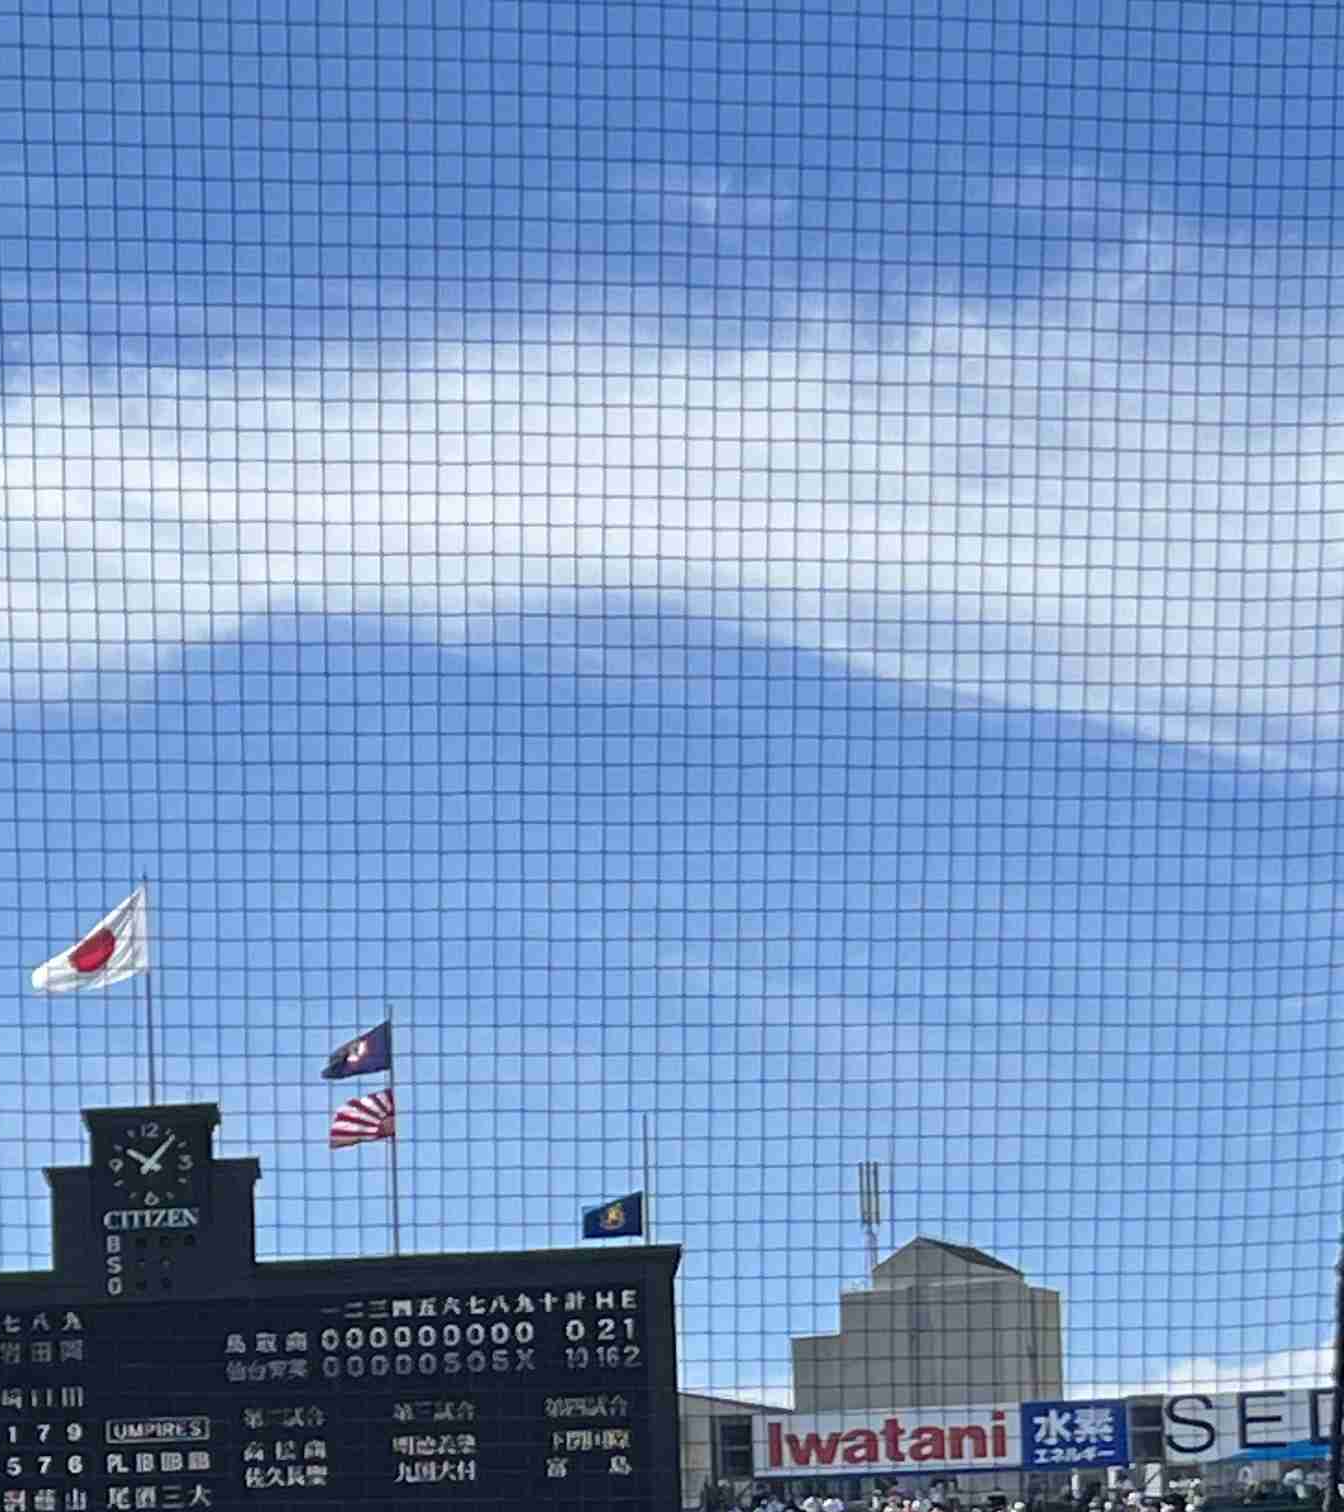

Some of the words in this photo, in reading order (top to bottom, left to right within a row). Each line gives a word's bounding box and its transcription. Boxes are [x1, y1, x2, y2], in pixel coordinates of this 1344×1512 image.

[141, 1122, 159, 1138] 12
[178, 1154, 193, 1170] 3
[144, 1191, 159, 1206] 6
[103, 1207, 199, 1230] CITIZEN
[107, 1235, 120, 1253] B
[106, 1256, 122, 1274] S
[596, 1291, 614, 1310] H
[622, 1289, 638, 1309] E
[598, 1319, 616, 1340] 2
[8, 1426, 17, 1443] 1
[37, 1424, 50, 1442] 7
[67, 1424, 81, 1441] 9
[114, 1421, 203, 1441] UMPIRES
[1033, 1408, 1115, 1446] 水素
[767, 1411, 1006, 1467] Iwatani
[108, 1455, 128, 1474] PL
[1033, 1446, 1115, 1465] エネルギー
[8, 1458, 21, 1475] 5
[39, 1457, 52, 1474] 7
[68, 1456, 82, 1473] 6
